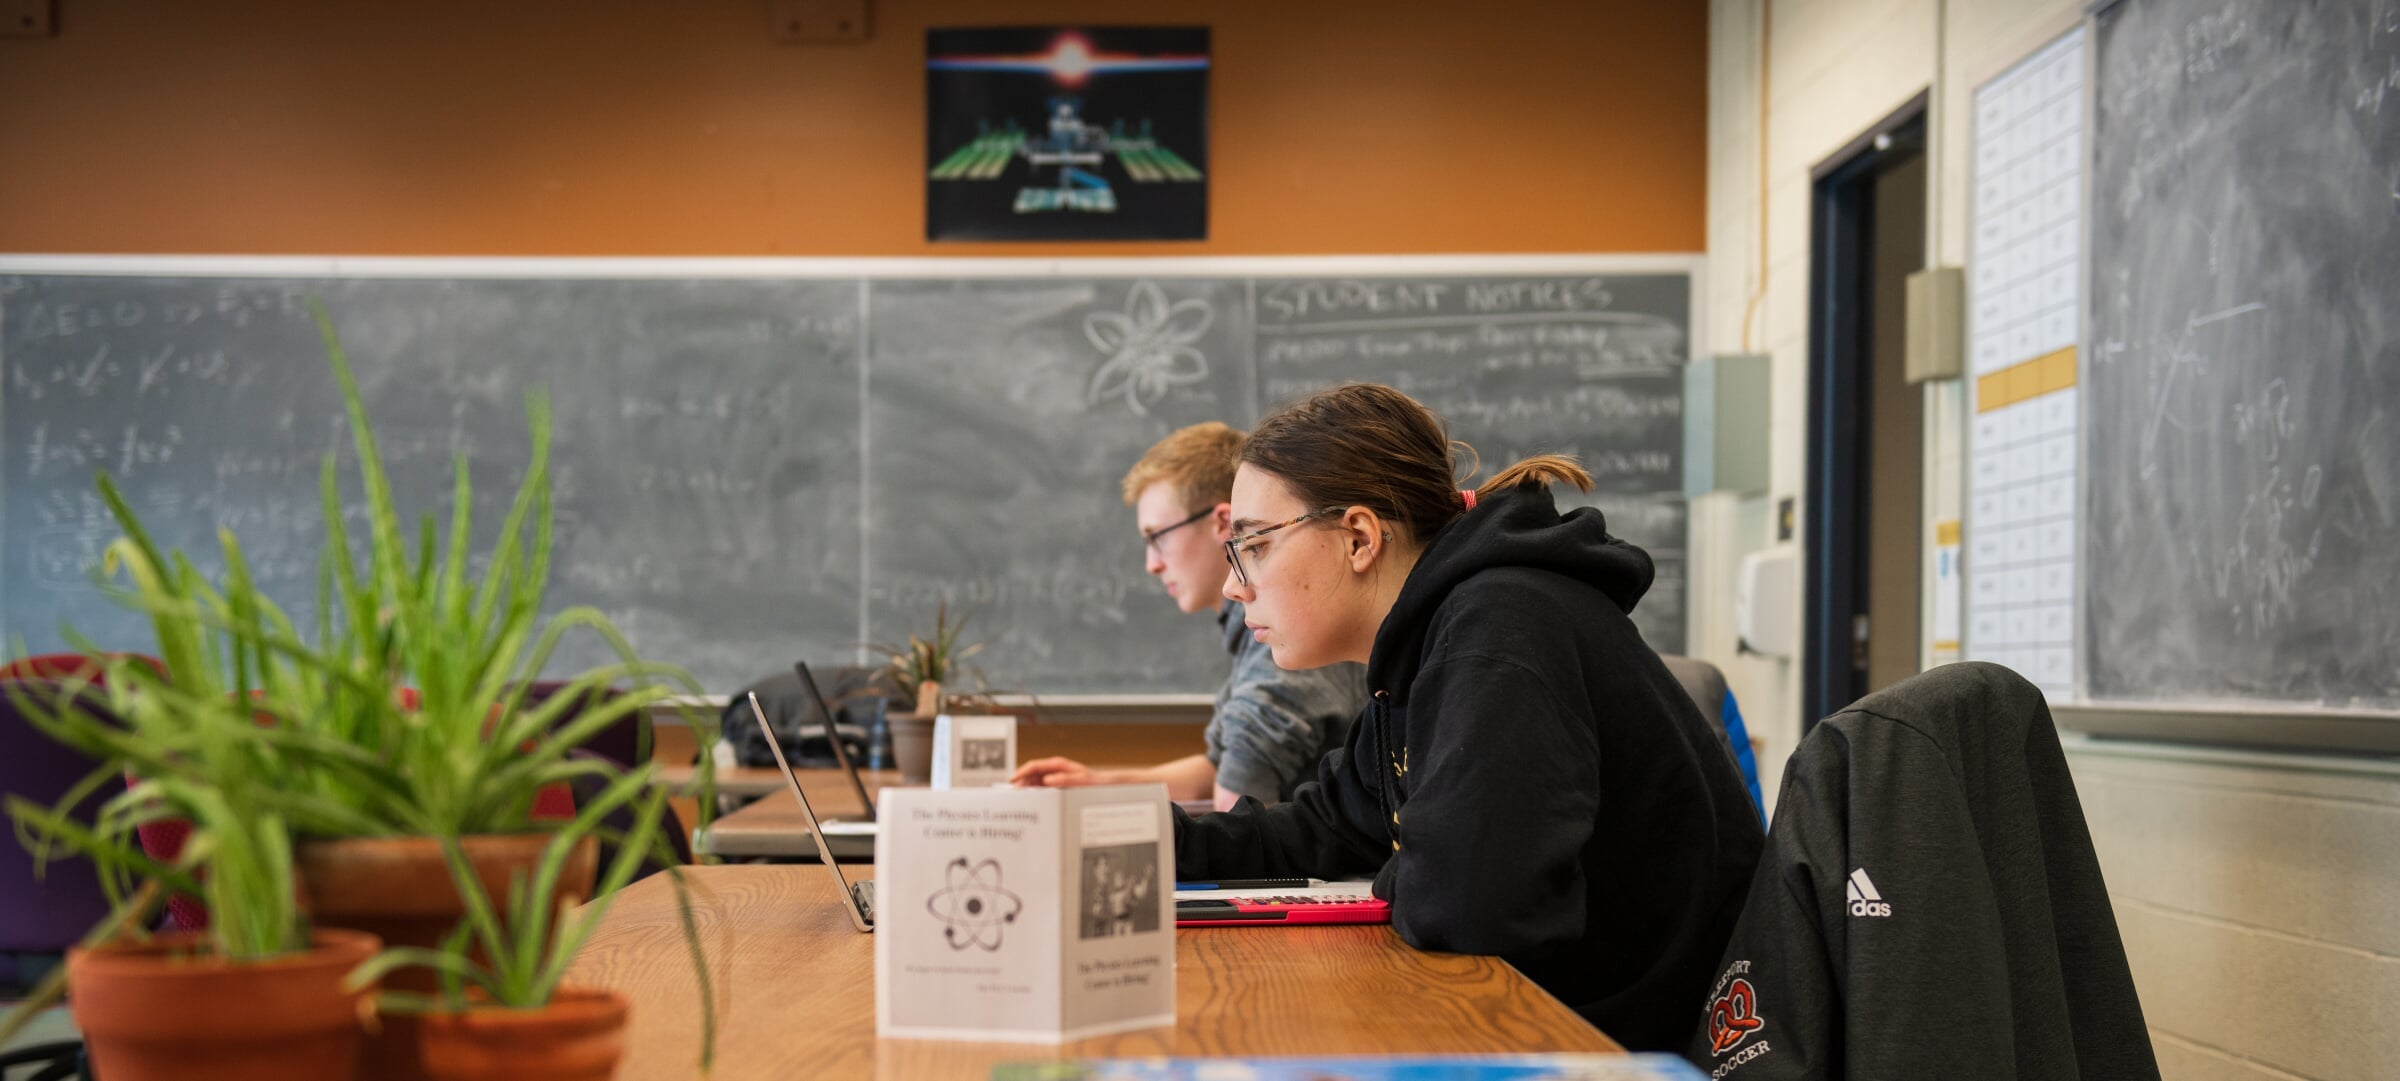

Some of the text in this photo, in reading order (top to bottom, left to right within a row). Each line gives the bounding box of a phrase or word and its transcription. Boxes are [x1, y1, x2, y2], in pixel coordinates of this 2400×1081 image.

[1262, 279, 1450, 320] STUDENT
[912, 808, 1040, 824] The Physics Learning
[1712, 1040, 1771, 1081] SOCCER
